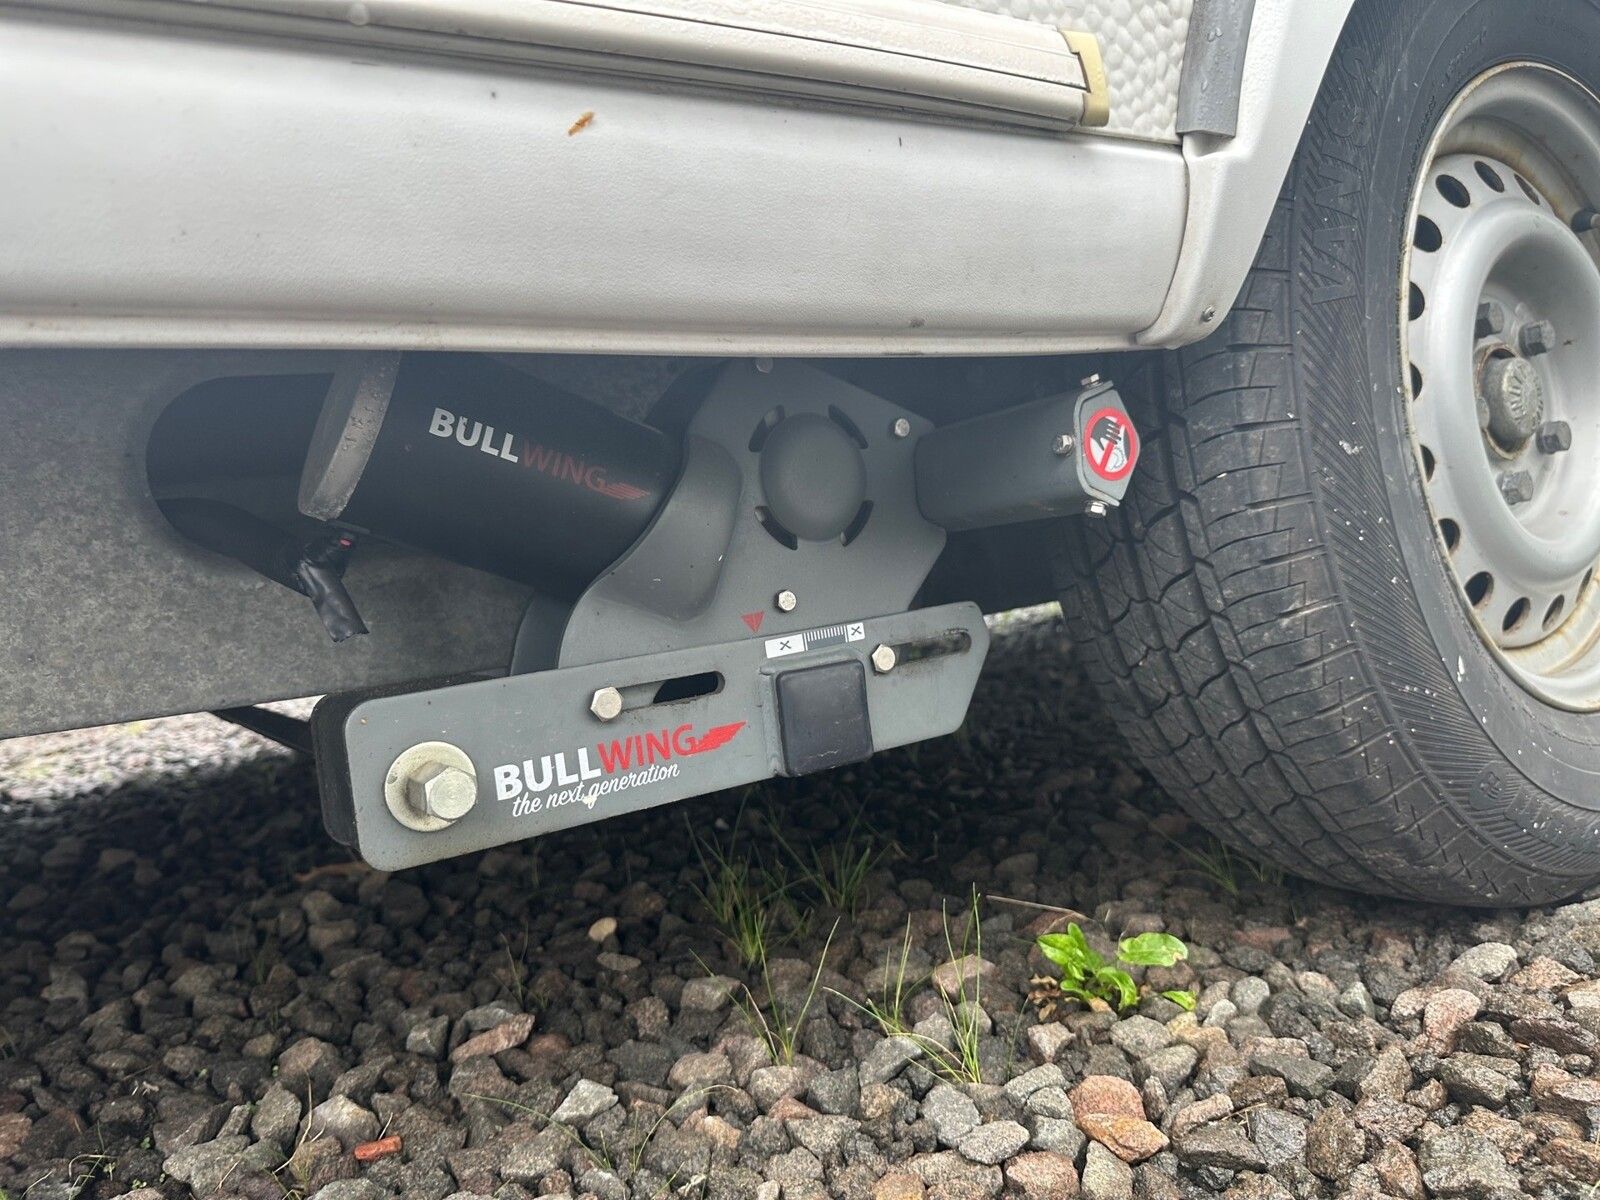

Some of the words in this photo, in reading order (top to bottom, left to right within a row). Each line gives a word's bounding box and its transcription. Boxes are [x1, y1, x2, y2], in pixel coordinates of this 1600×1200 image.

[428, 407, 608, 492] BULLWING
[494, 723, 694, 801] BULLWING
[512, 791, 543, 817] the
[546, 781, 585, 809] next
[587, 762, 681, 809] generation
